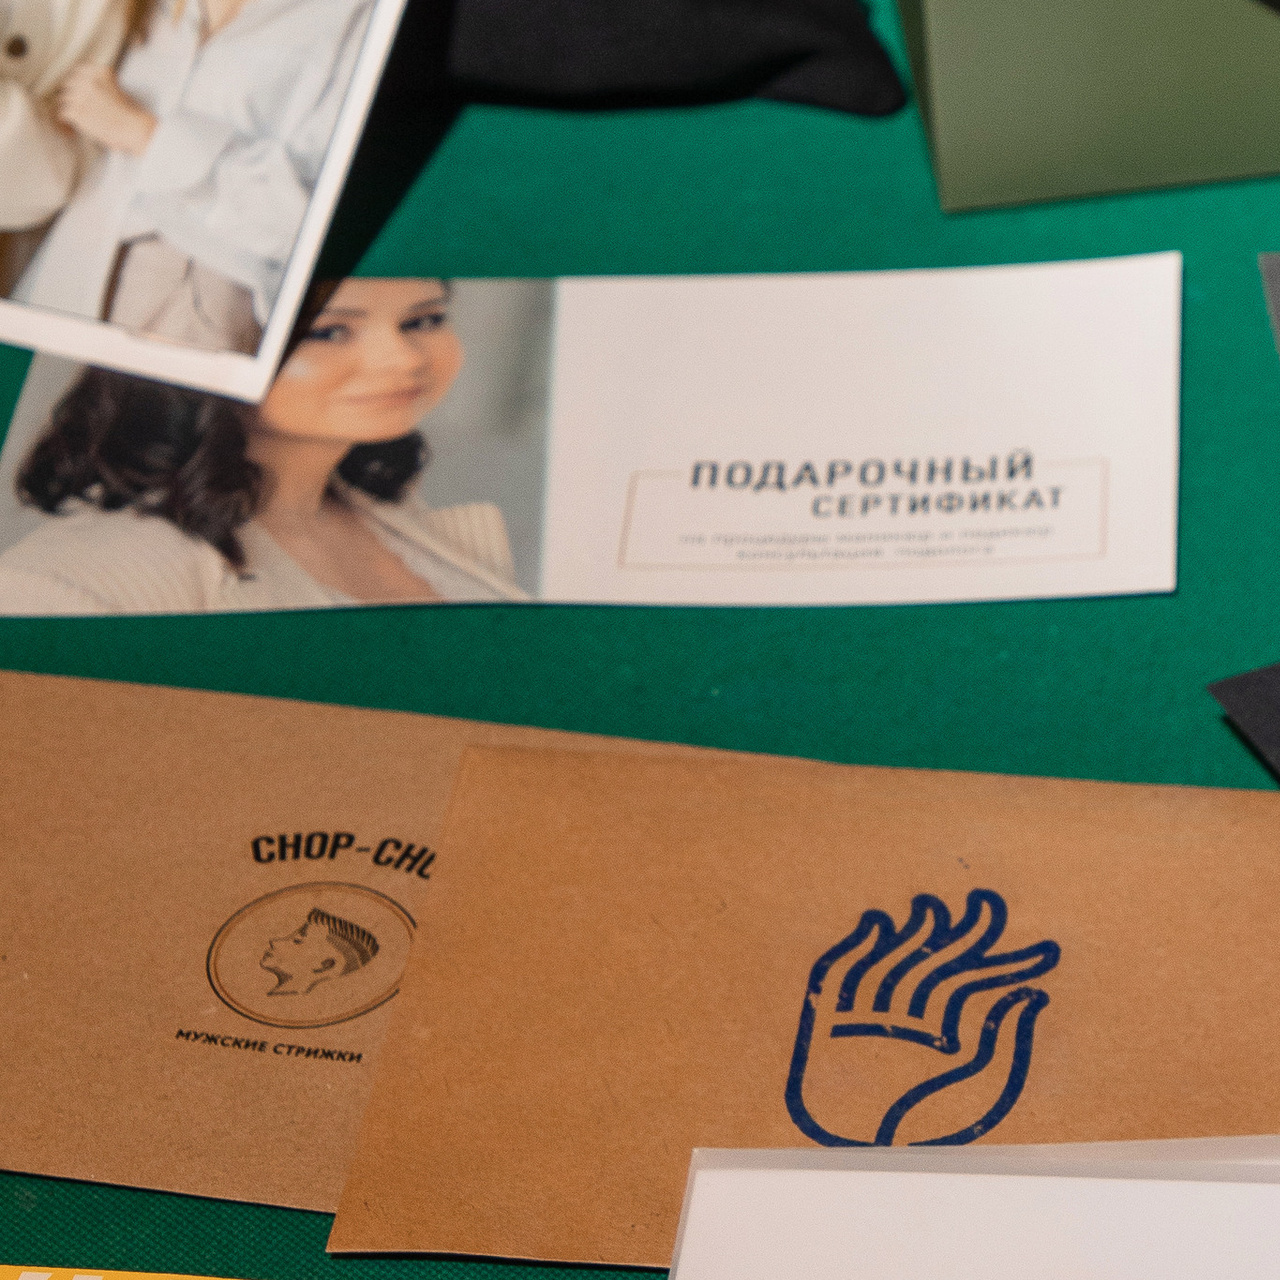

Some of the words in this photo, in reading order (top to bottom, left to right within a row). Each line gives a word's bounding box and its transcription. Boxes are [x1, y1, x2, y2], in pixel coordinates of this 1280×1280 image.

[690, 446, 1034, 492] ПОДАРОЧНЫЙ
[811, 486, 1065, 518] СЕРТИФИКАТ
[175, 1028, 268, 1052] МУЖСКИЕ
[273, 1043, 363, 1063] СТРИЖКИ
